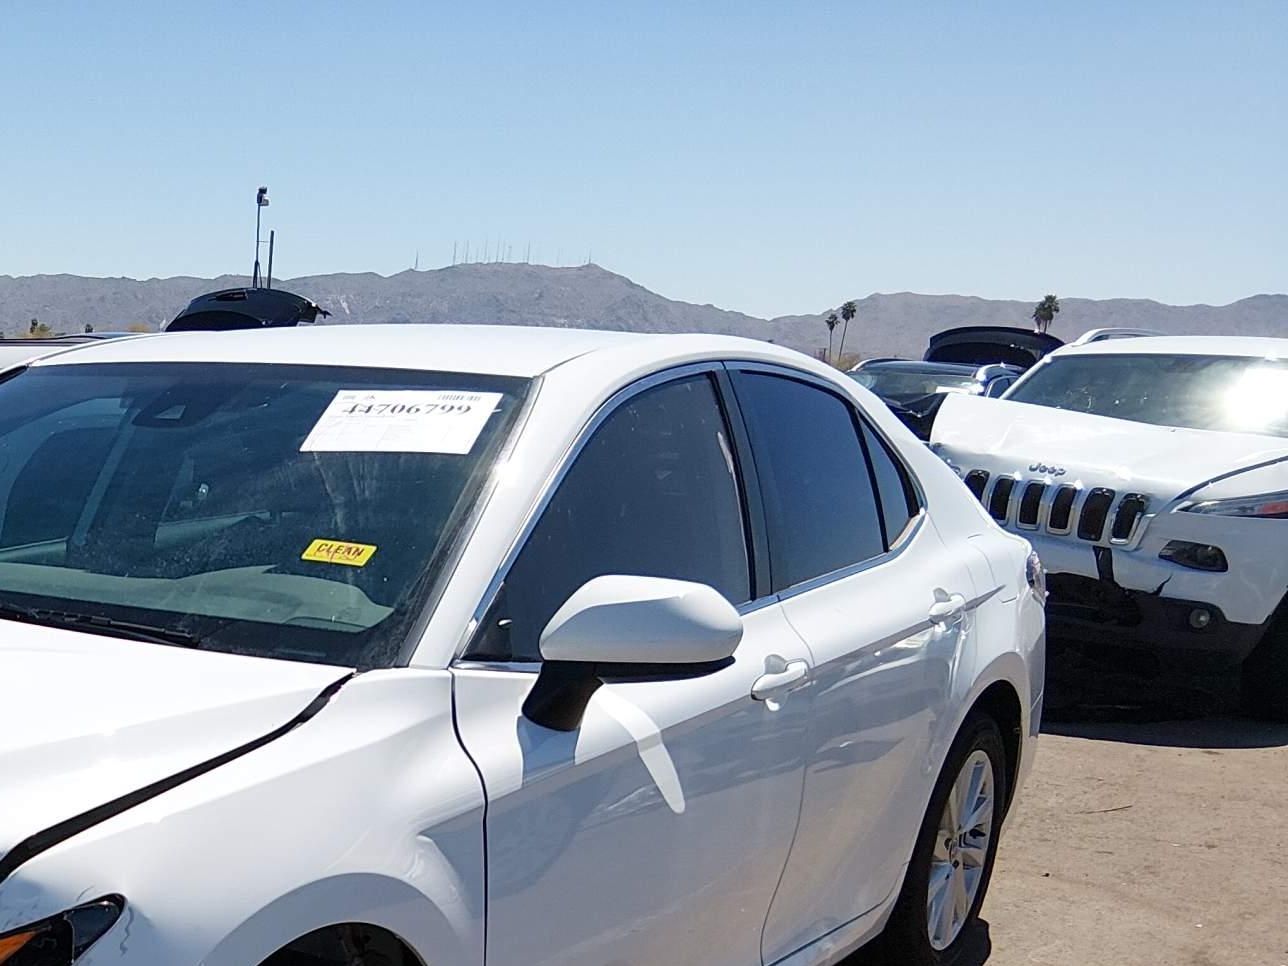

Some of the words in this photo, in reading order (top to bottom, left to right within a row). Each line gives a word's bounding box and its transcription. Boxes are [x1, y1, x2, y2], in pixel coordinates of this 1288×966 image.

[341, 403, 472, 415] 44706799
[1029, 462, 1066, 477] Jeep
[316, 543, 364, 557] CLEAN
